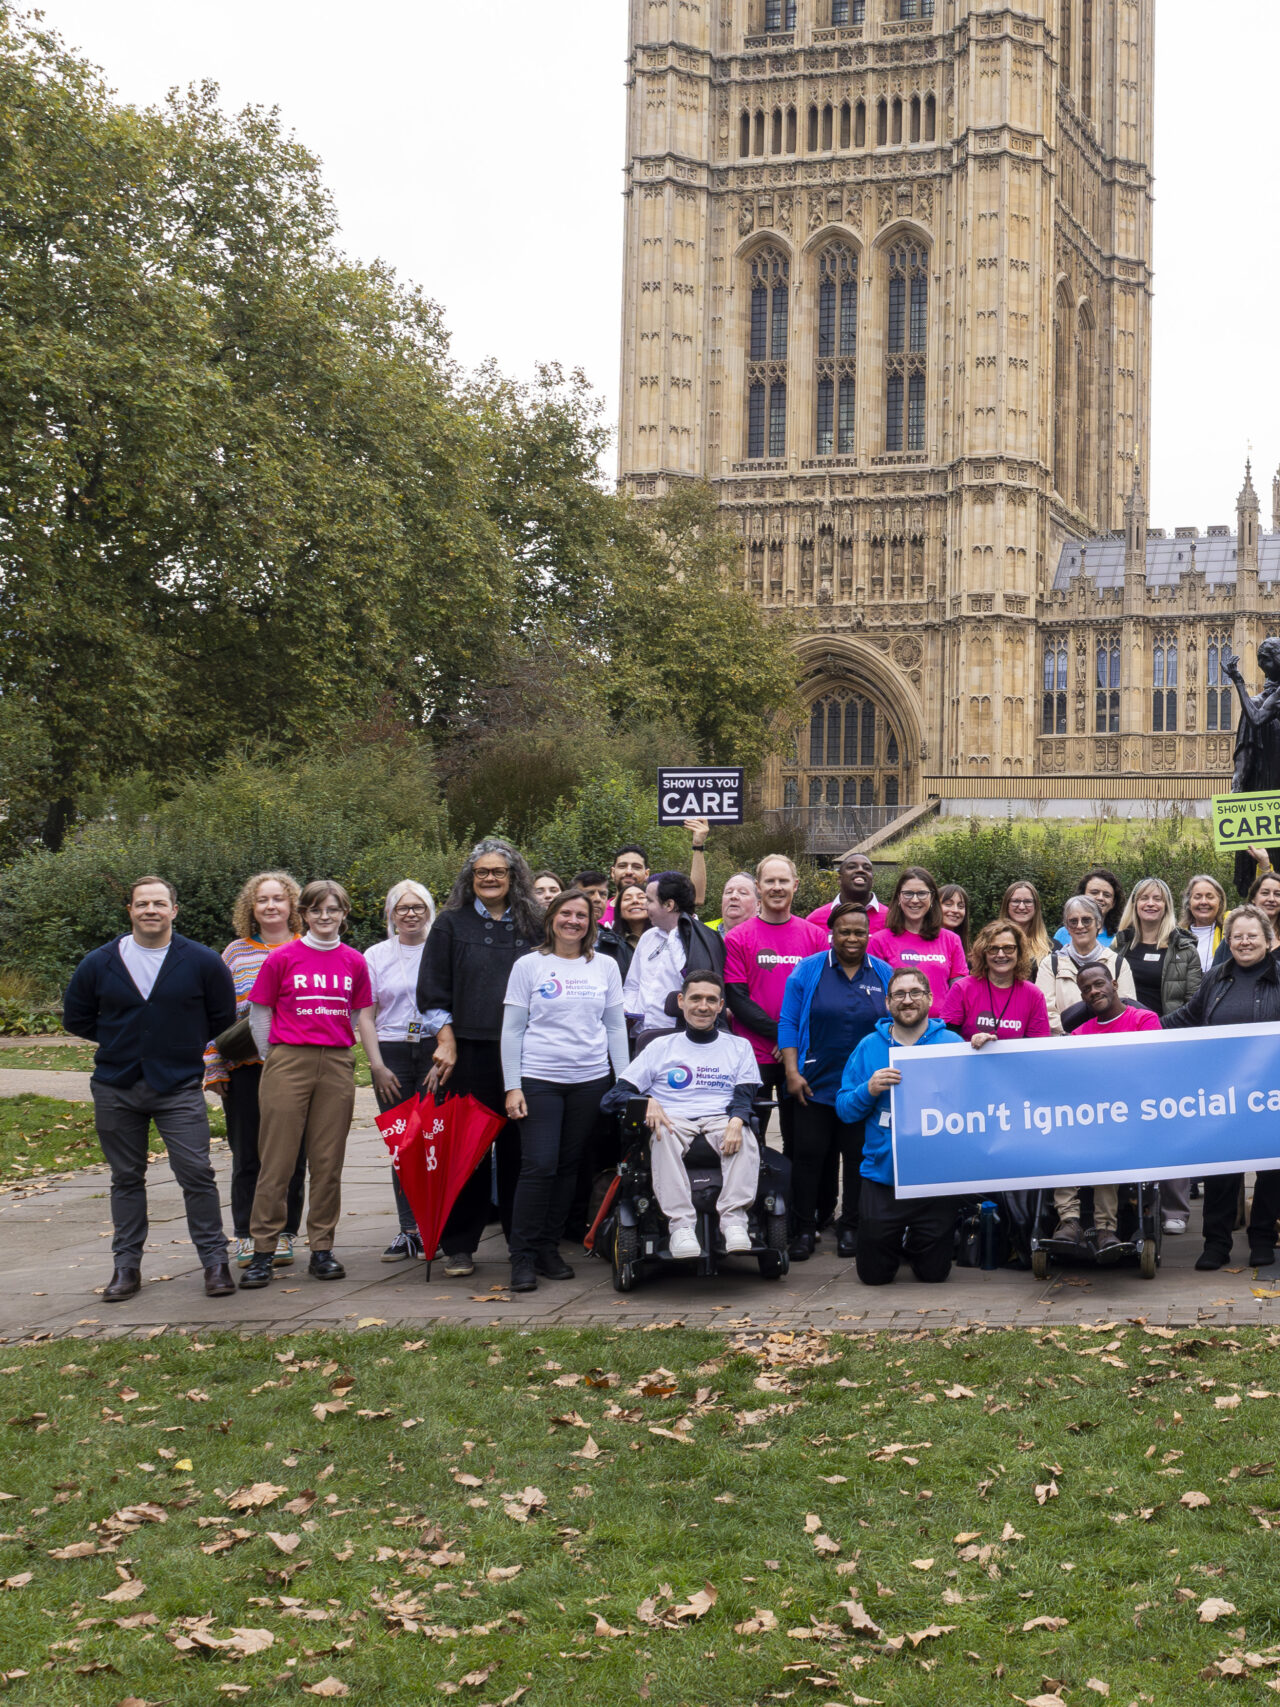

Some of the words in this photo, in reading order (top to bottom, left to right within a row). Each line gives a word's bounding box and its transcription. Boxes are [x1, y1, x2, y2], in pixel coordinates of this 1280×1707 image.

[663, 779, 695, 789] SHOW
[697, 779, 714, 789] US
[716, 779, 739, 788] YOU
[662, 792, 739, 814] CARE
[1217, 804, 1247, 814] SHOW
[1249, 803, 1264, 812] US
[901, 953, 946, 964] mencap
[293, 973, 353, 991] RNIB
[296, 1007, 313, 1016] See
[696, 1080, 725, 1088] Atrophy
[920, 1102, 1011, 1137] Don't
[1023, 1100, 1129, 1135] ignore
[1140, 1085, 1237, 1121] social
